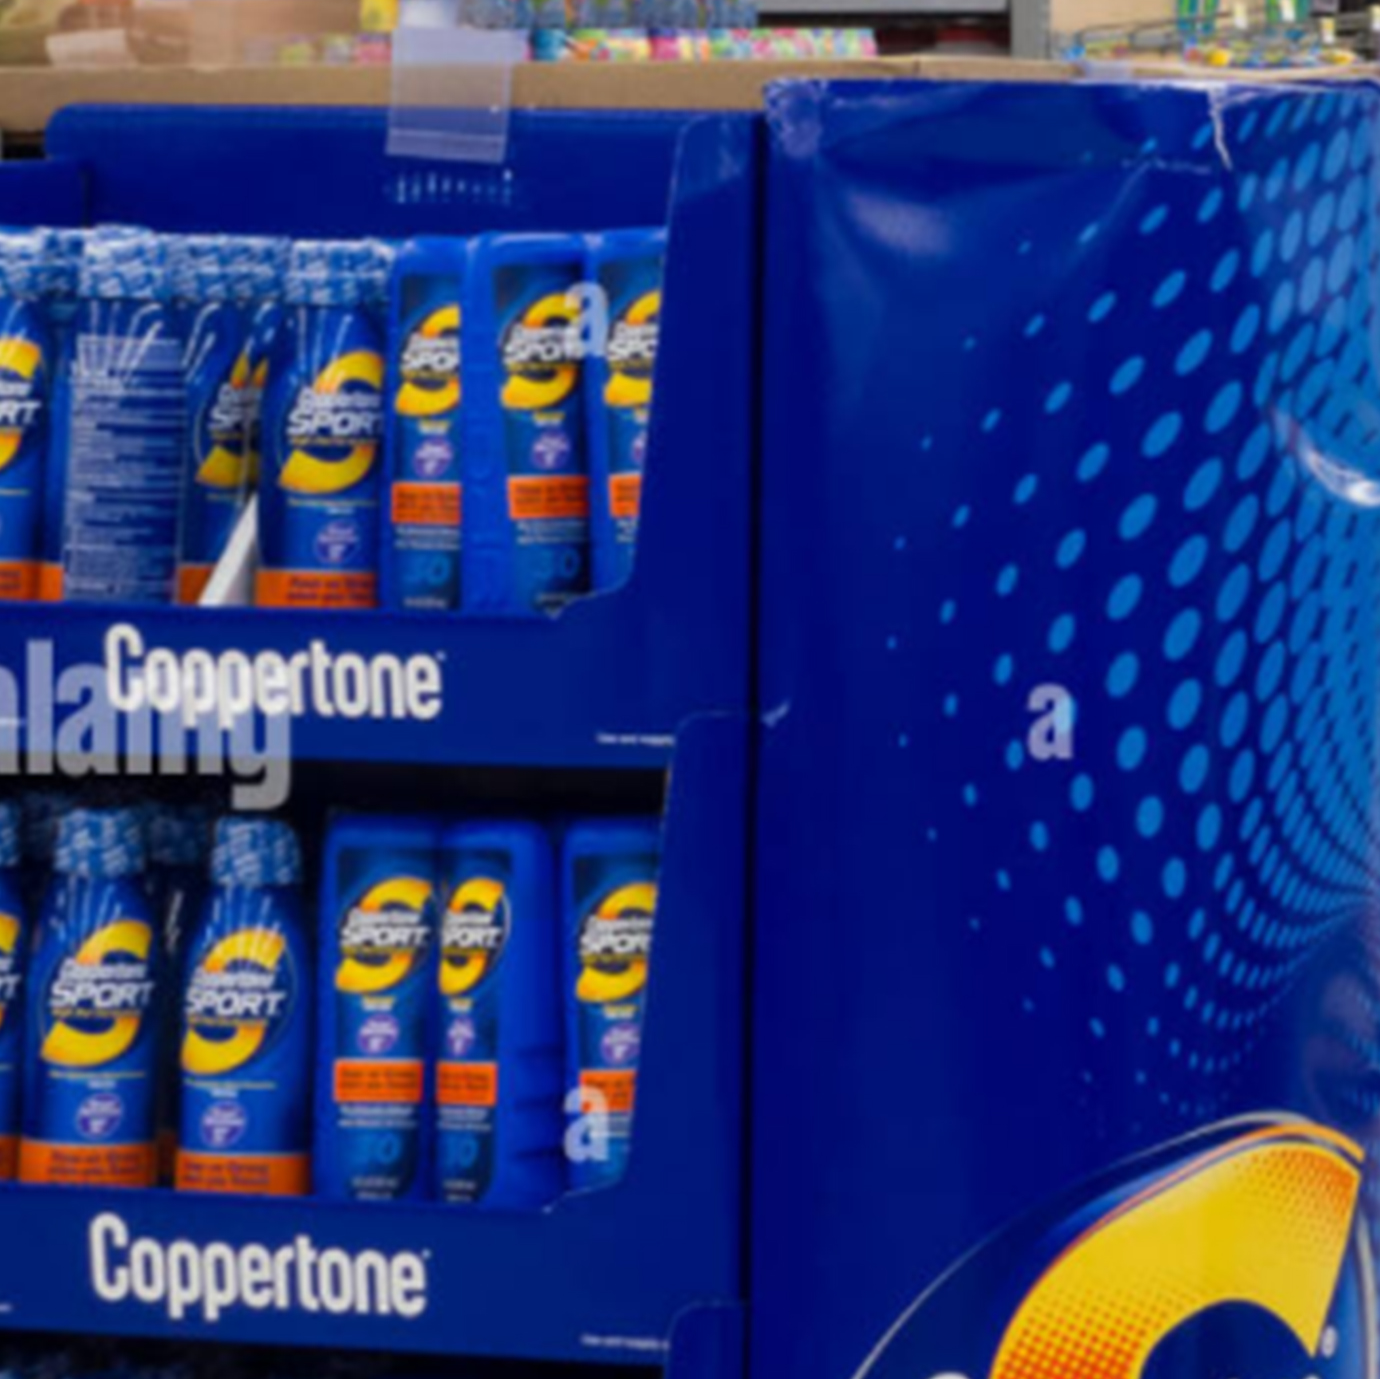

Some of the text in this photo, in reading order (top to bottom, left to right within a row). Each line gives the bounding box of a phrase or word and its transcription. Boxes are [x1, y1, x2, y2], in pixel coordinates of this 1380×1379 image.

[104, 623, 442, 729] Coppertone
[50, 981, 153, 1008] SPORT
[184, 990, 286, 1016] SPORT
[89, 1213, 427, 1321] Coppertone
